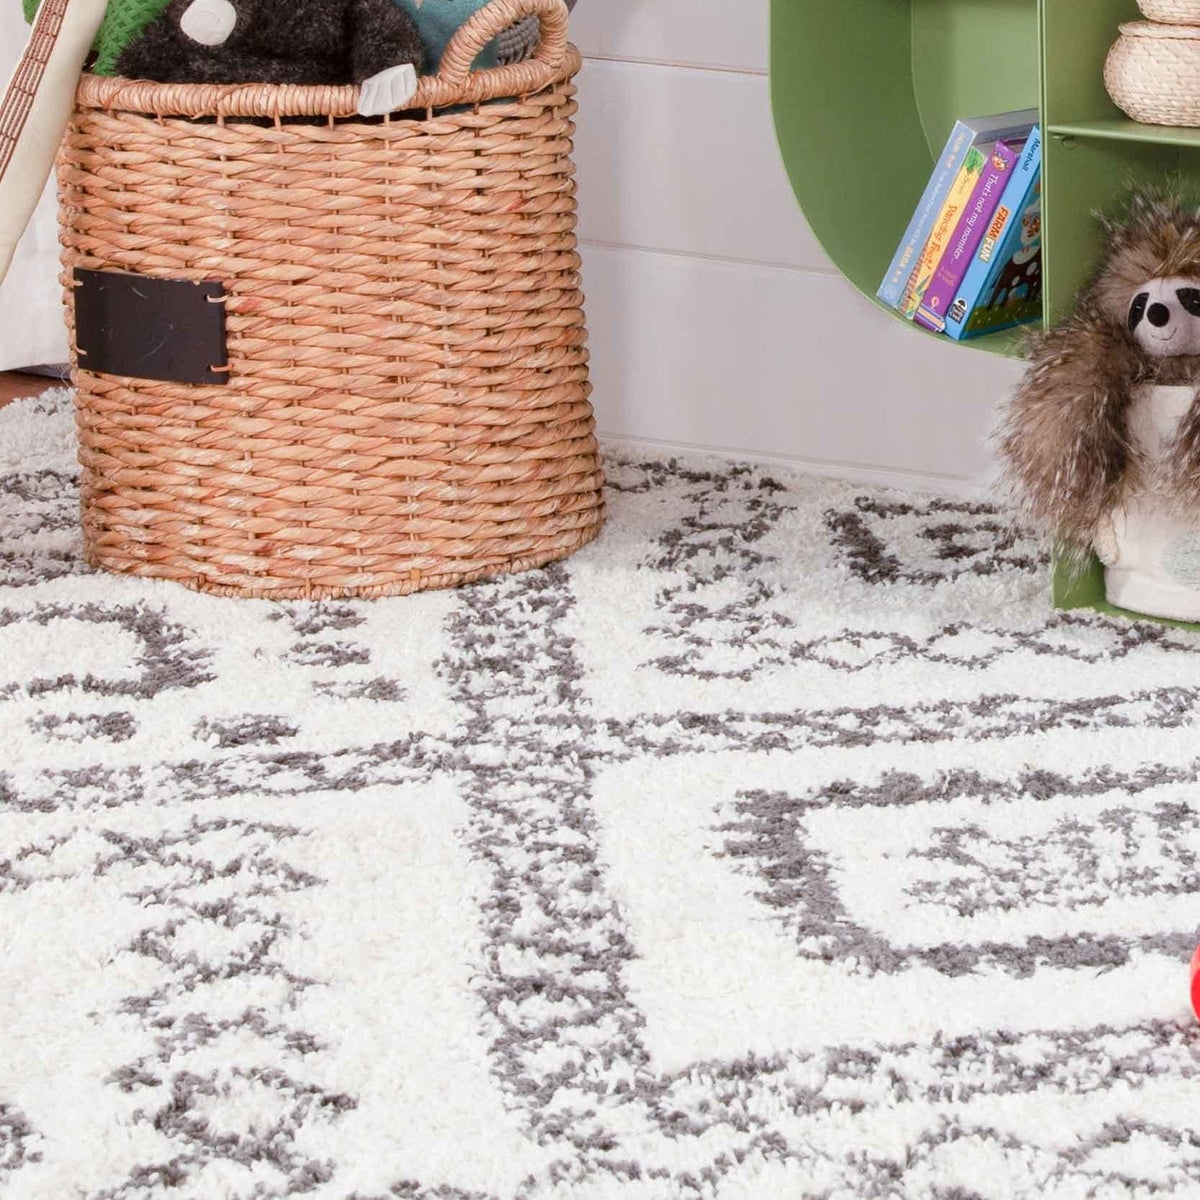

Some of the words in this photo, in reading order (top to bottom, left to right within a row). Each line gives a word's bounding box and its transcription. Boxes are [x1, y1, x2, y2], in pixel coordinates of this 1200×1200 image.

[1022, 138, 1040, 172] Marshall
[981, 172, 999, 199] That's
[975, 197, 988, 213] not
[934, 205, 957, 240] Dancing
[966, 211, 979, 228] my
[990, 206, 1009, 240] FARM
[979, 237, 995, 262] FUN
